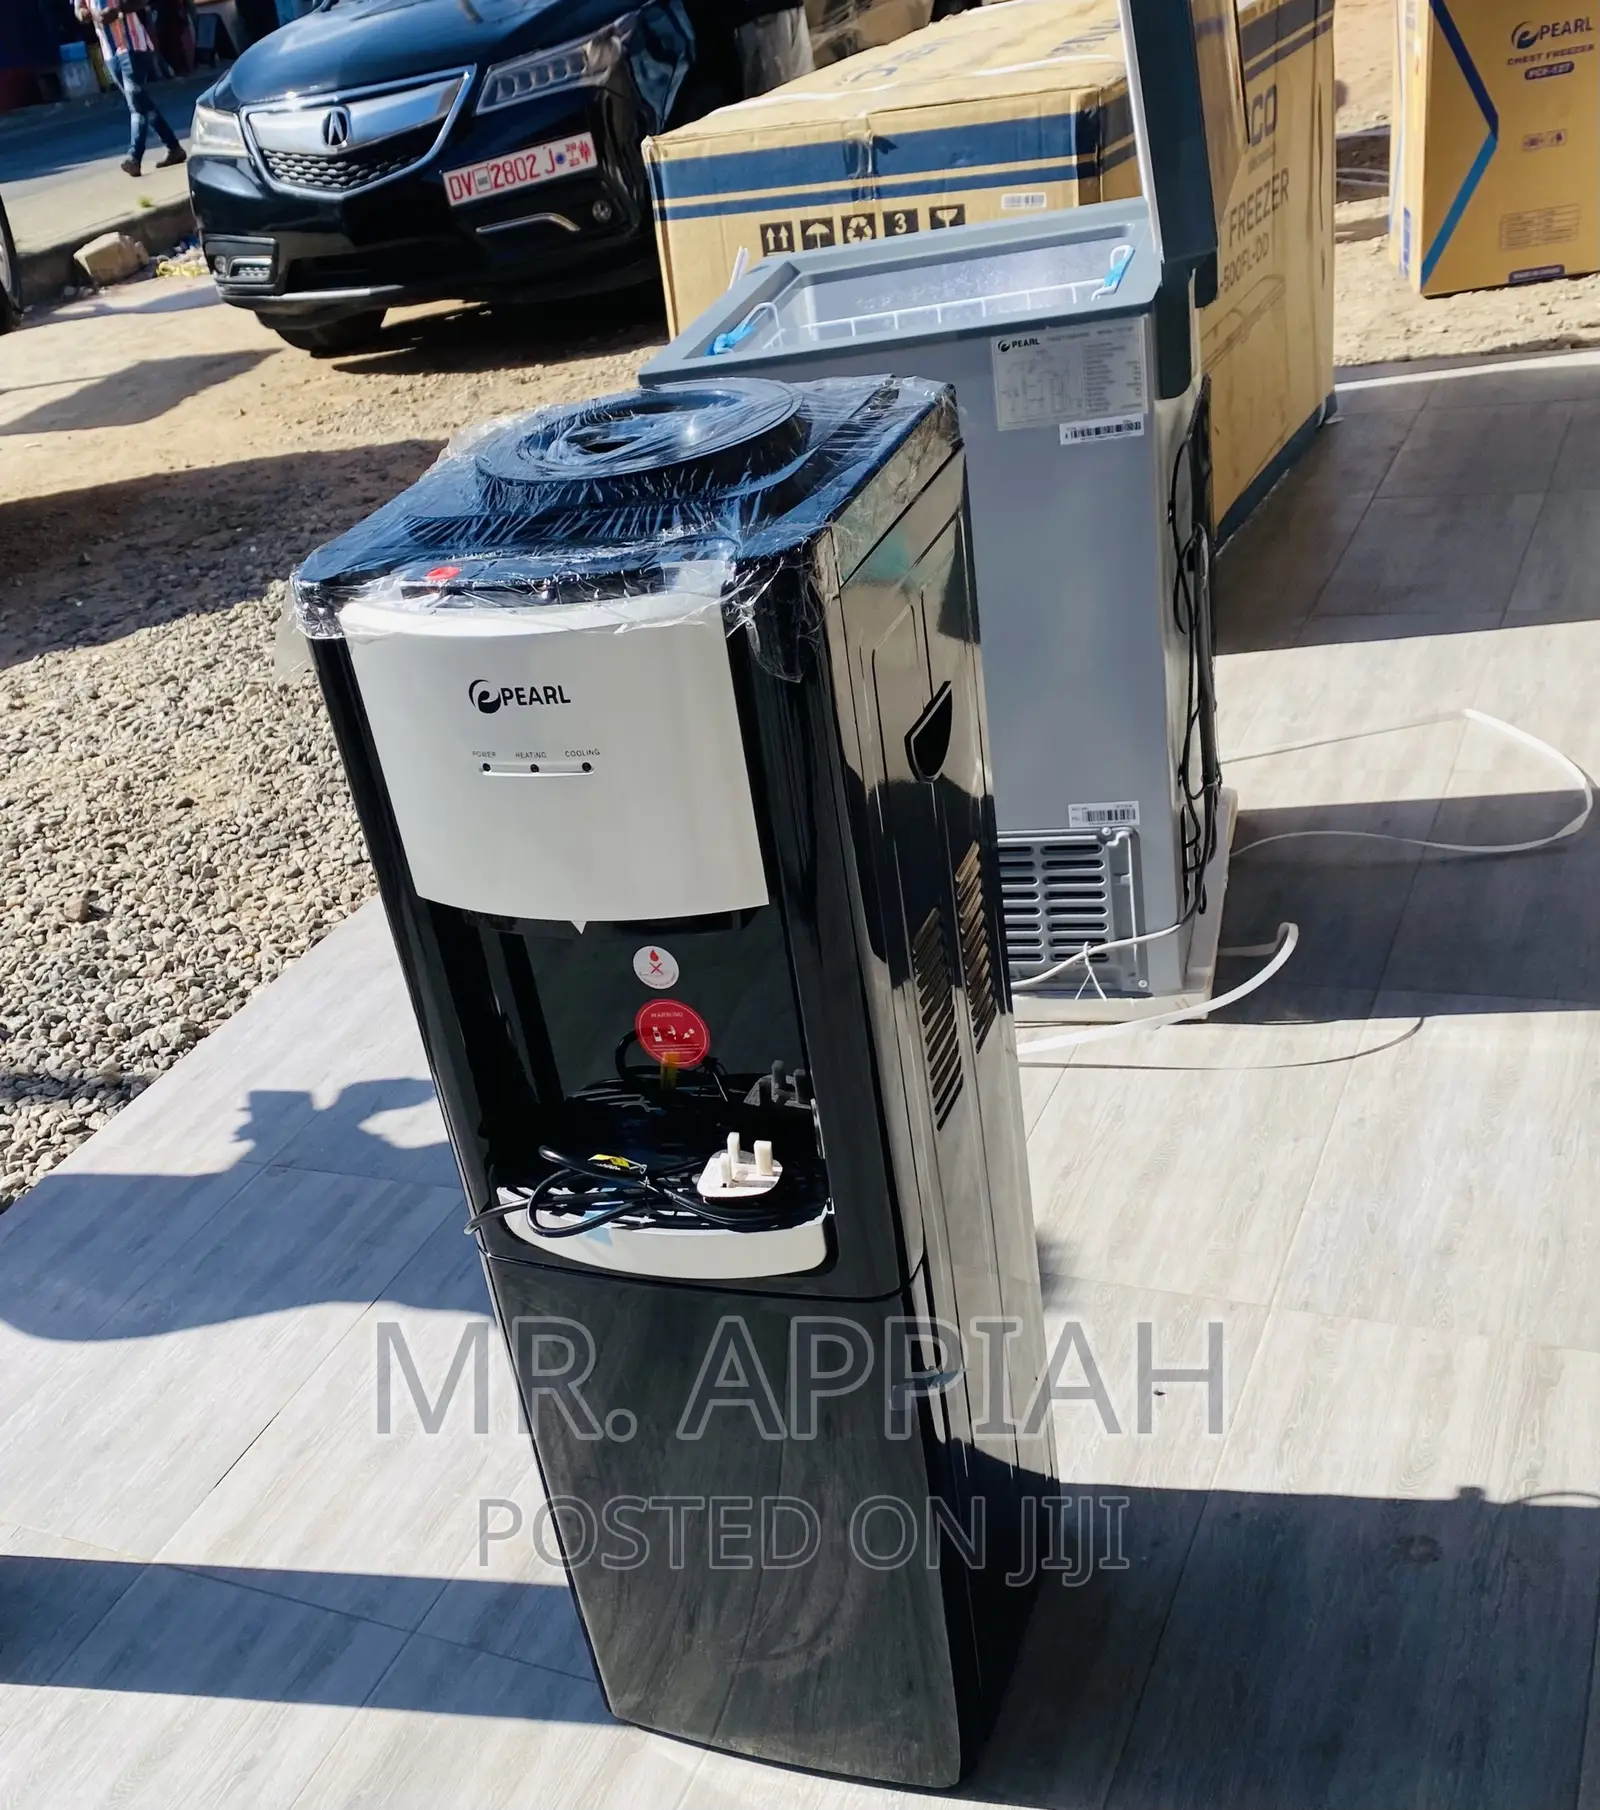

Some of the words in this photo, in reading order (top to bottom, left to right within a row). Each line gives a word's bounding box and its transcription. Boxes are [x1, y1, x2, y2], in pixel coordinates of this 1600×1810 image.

[1539, 17, 1594, 40] PEARL
[1247, 84, 1278, 147] CO
[448, 171, 473, 201] DV
[490, 153, 539, 189] 2802
[545, 148, 556, 174] J
[1229, 167, 1290, 249] FREEZER
[894, 212, 907, 234] 3
[1011, 337, 1041, 349] PEARL
[500, 684, 572, 706] PEARL
[472, 750, 496, 759] POWER
[515, 750, 547, 759] HEATING
[564, 748, 601, 758] COOLING
